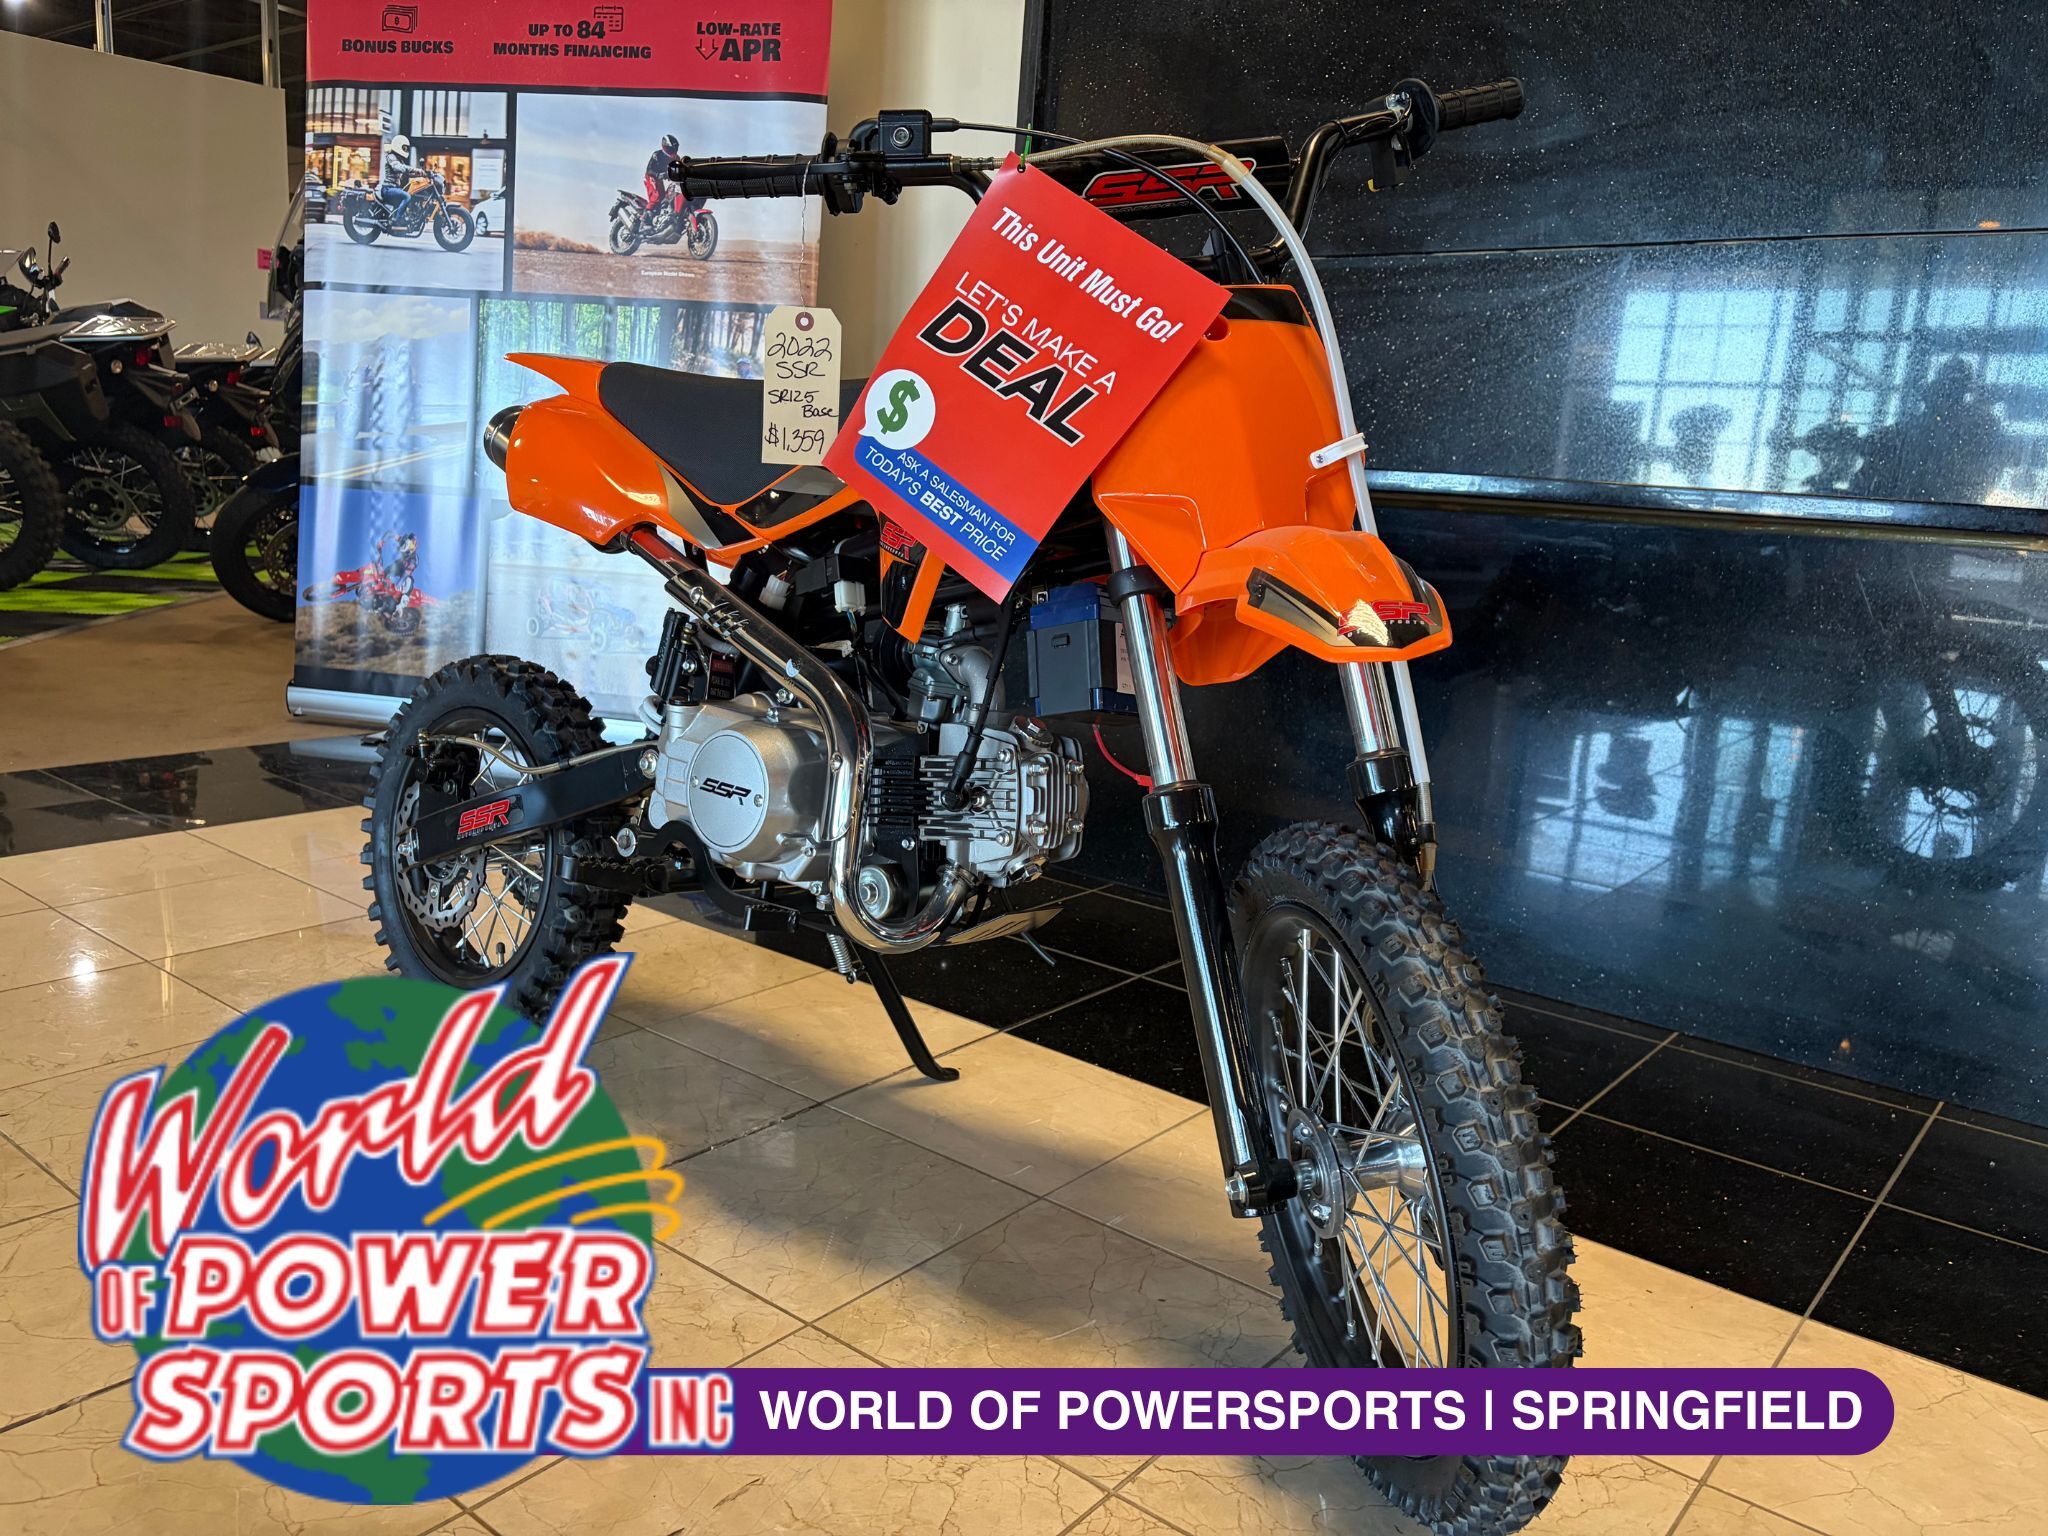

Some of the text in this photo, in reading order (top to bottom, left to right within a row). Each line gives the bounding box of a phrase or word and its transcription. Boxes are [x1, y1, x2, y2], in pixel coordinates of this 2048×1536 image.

[528, 20, 606, 39] UP TO 84
[696, 21, 781, 36] LOW-RATE
[341, 38, 455, 55] BONUS BUCKS
[493, 42, 652, 59] MONTHS FINANCING
[718, 38, 781, 62] APR
[991, 206, 1184, 343] This Unit Must Go!
[767, 332, 833, 362] 2022
[954, 271, 1117, 395] LET'S MAKE A
[775, 361, 826, 380] SSR
[915, 295, 1100, 448] DEAL
[767, 388, 820, 405] SR125
[801, 404, 840, 419] Base
[764, 421, 825, 455] $1,359
[864, 445, 1008, 562] TODAY'S BEST PRICE
[897, 451, 1017, 546] ASK A SALESMAN FOR
[700, 777, 752, 806] SSR
[457, 799, 510, 834] SSR
